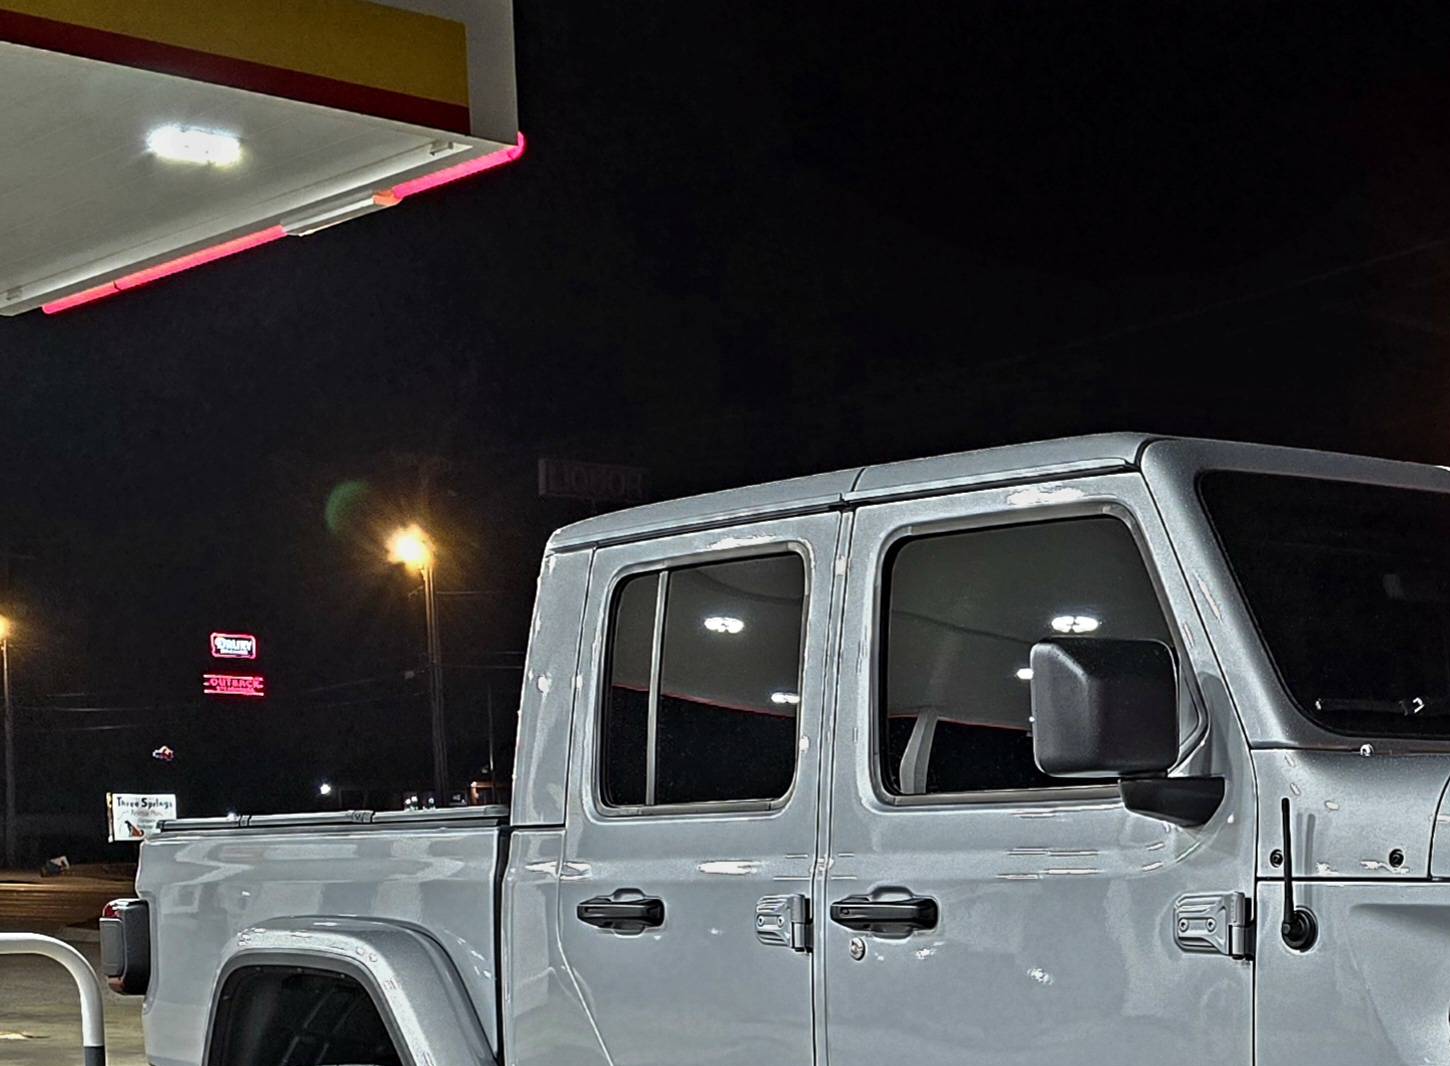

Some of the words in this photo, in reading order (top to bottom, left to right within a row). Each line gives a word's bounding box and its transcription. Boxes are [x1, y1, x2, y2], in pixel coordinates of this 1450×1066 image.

[210, 677, 260, 688] OUTBACK
[116, 796, 139, 808] Three
[141, 797, 173, 810] Springs
